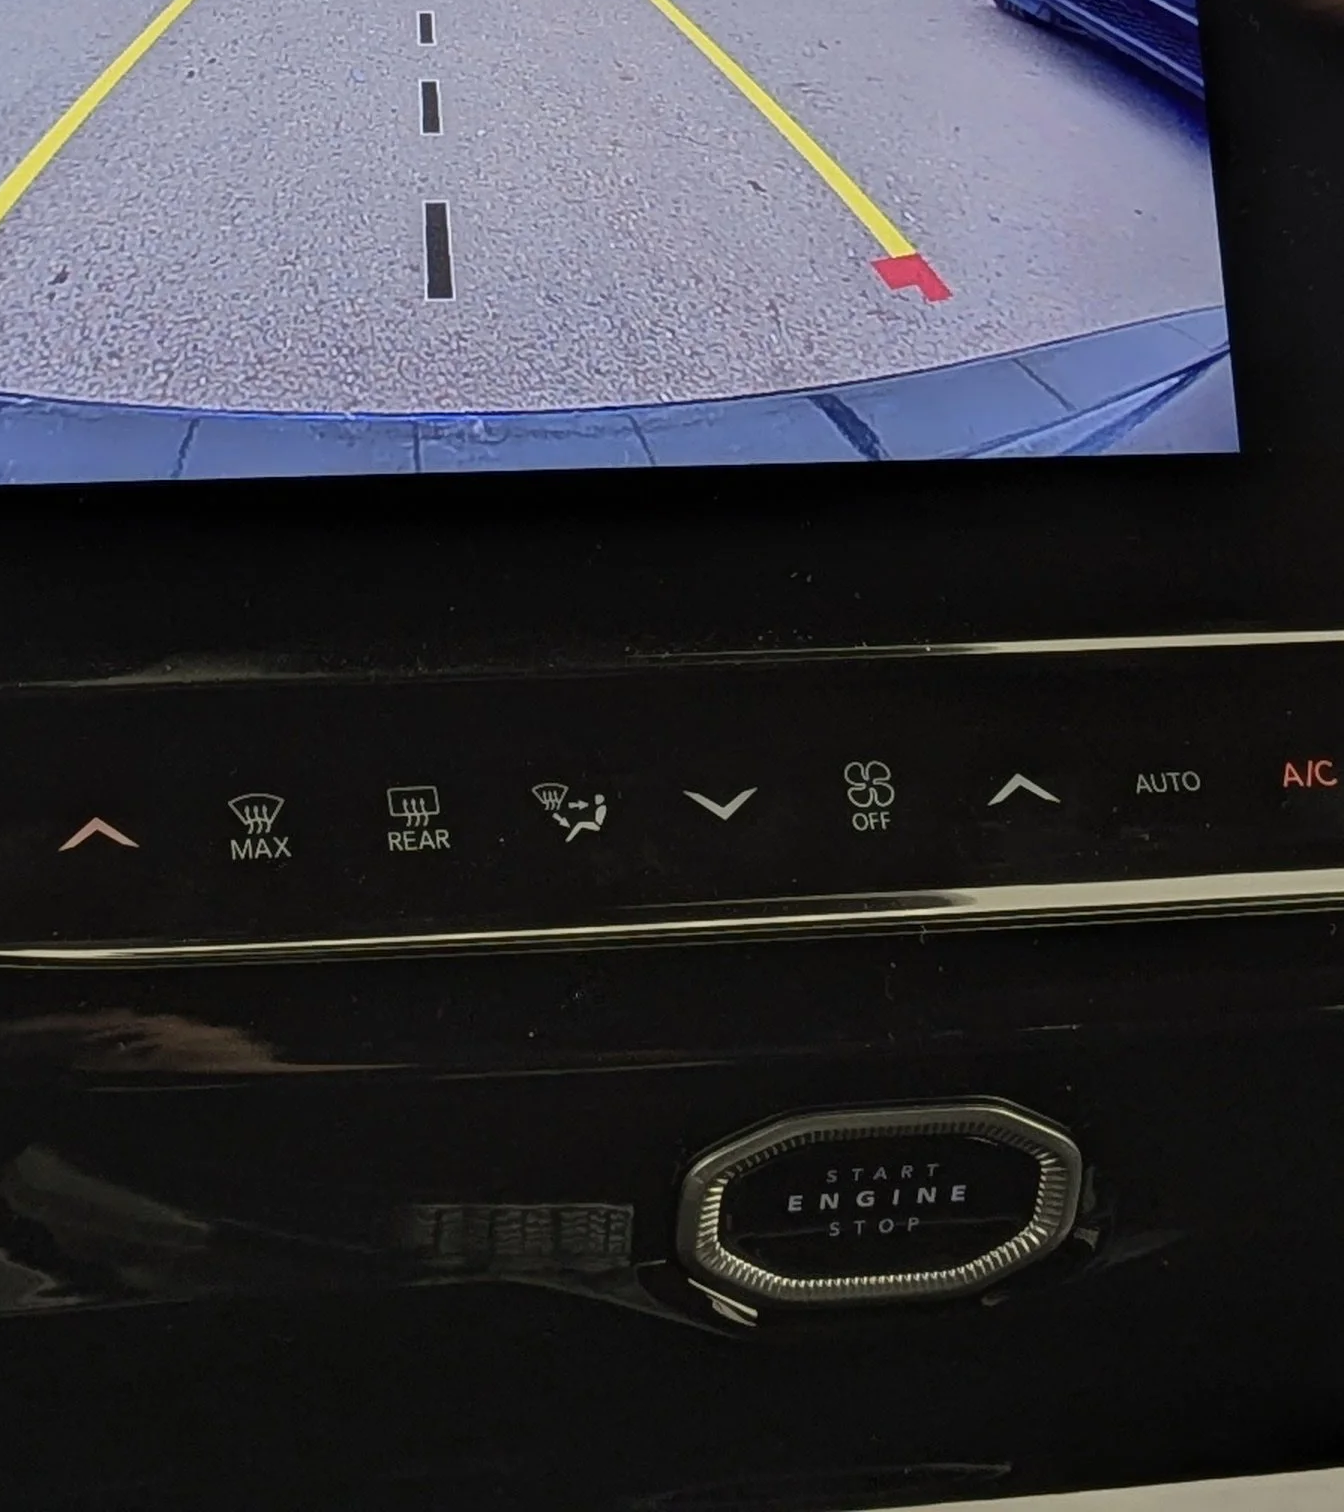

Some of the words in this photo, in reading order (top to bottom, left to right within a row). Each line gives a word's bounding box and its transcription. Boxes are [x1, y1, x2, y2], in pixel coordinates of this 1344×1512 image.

[1135, 770, 1202, 796] AUTO
[1282, 759, 1339, 788] A/C
[851, 812, 892, 832] OFF
[229, 835, 293, 861] MAX
[387, 829, 451, 852] REAR
[826, 1163, 940, 1183] START
[788, 1185, 967, 1212] ENGINE
[829, 1217, 920, 1237] STOP
